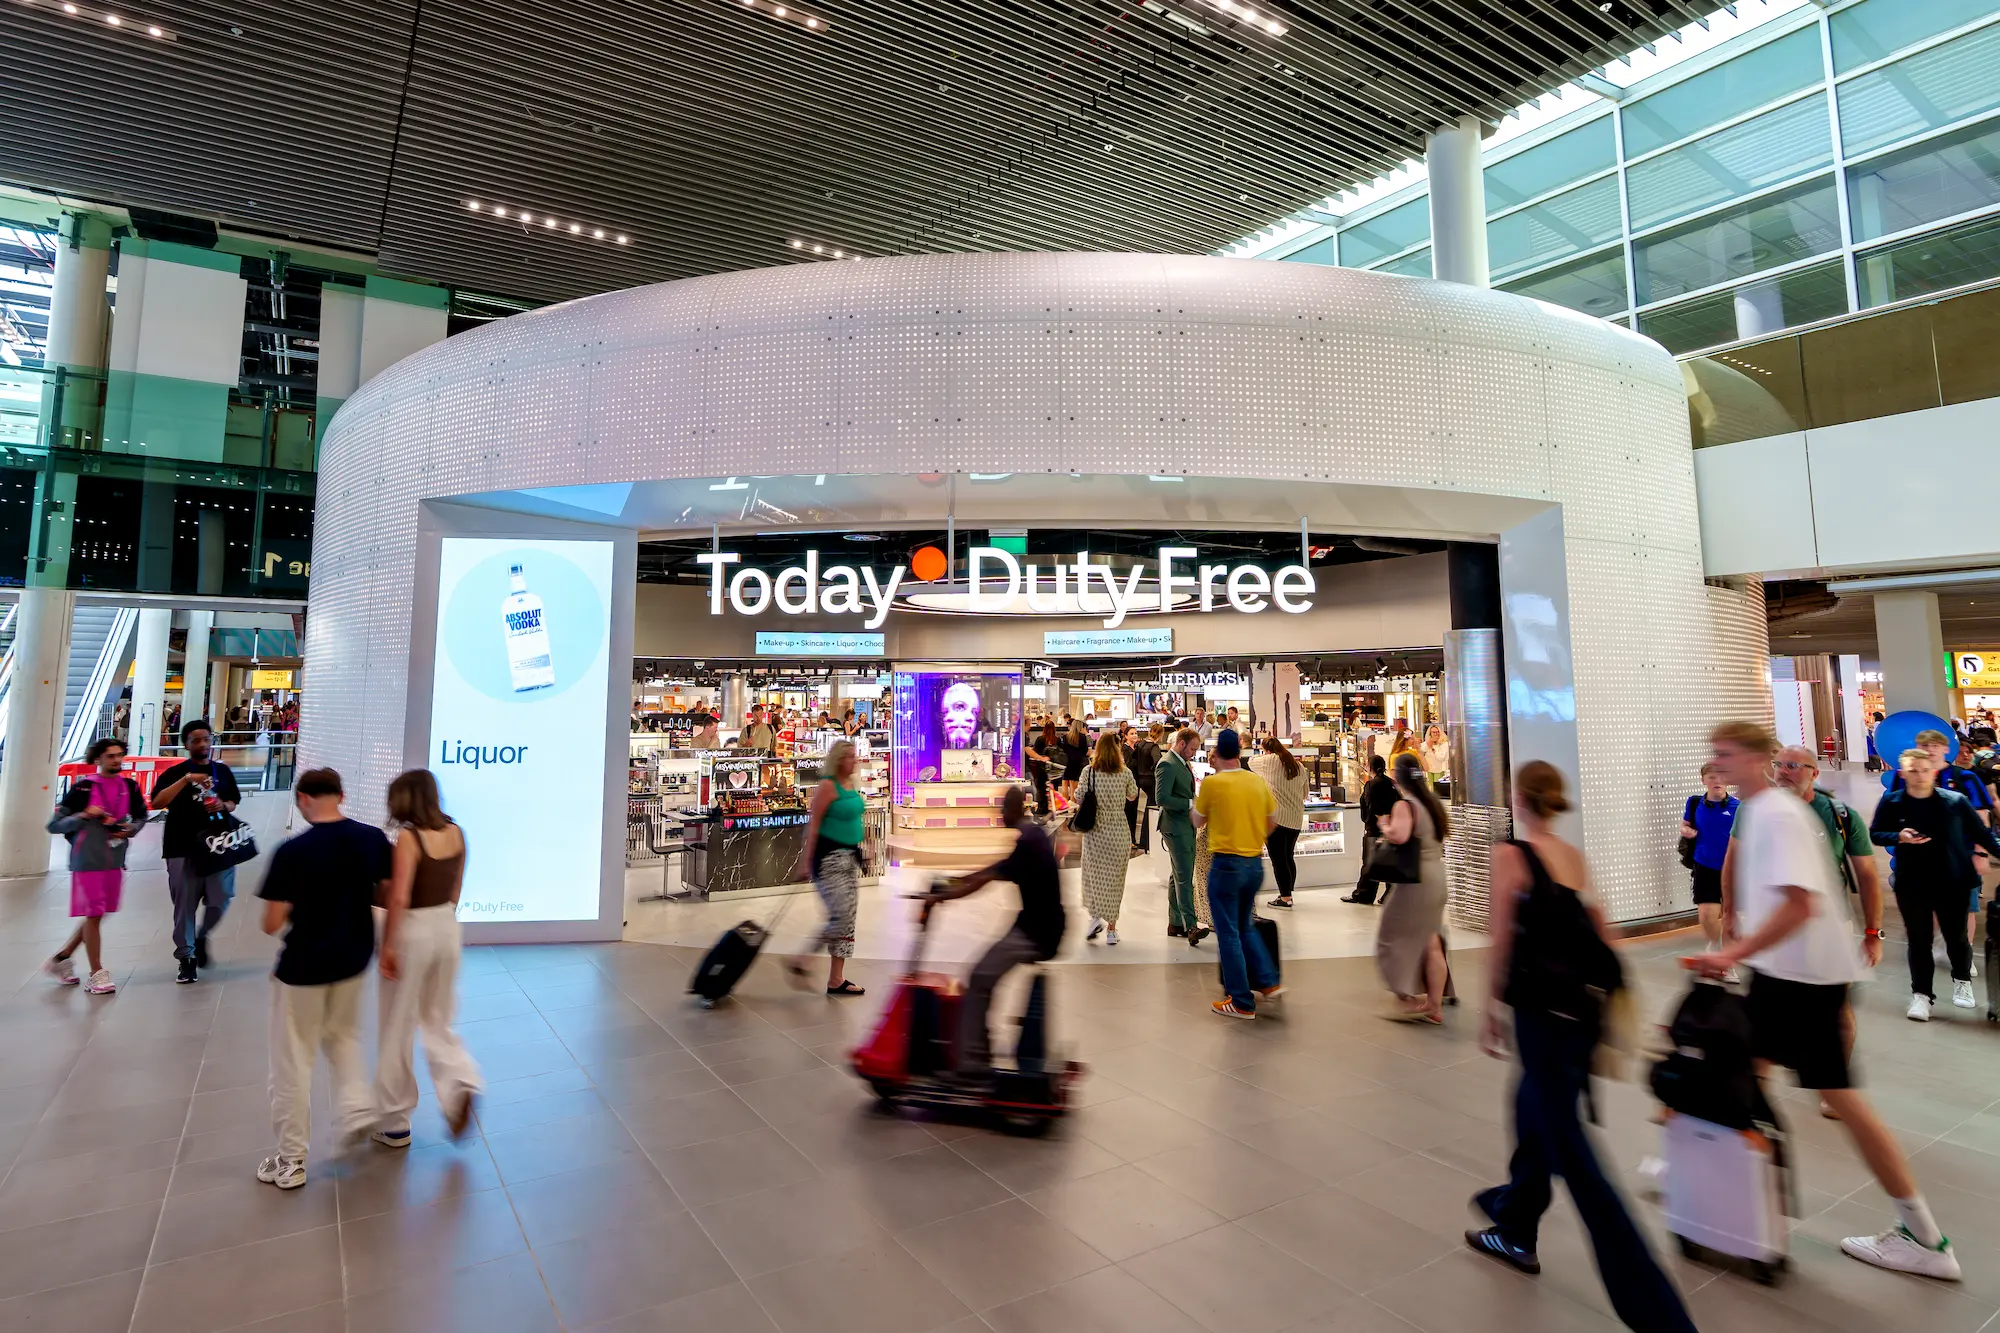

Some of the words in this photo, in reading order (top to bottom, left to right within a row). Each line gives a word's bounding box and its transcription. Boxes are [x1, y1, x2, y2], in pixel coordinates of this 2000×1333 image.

[697, 549, 906, 629] Today
[968, 547, 1143, 628] Duty
[1158, 547, 1316, 614] Free
[505, 608, 542, 624] ABSOLUT
[509, 618, 540, 631] VODKA
[763, 639, 794, 648] Make-up
[801, 639, 831, 647] Skincare
[836, 640, 858, 649] Liquor
[1052, 638, 1080, 646] Haircare
[1086, 637, 1121, 646] Fragrance
[1127, 636, 1158, 644] Make-up
[442, 740, 528, 769] Liquor
[736, 818, 761, 828] YVES
[762, 817, 790, 827] SAINT
[472, 902, 498, 914] Duty
[500, 901, 524, 911] Free
